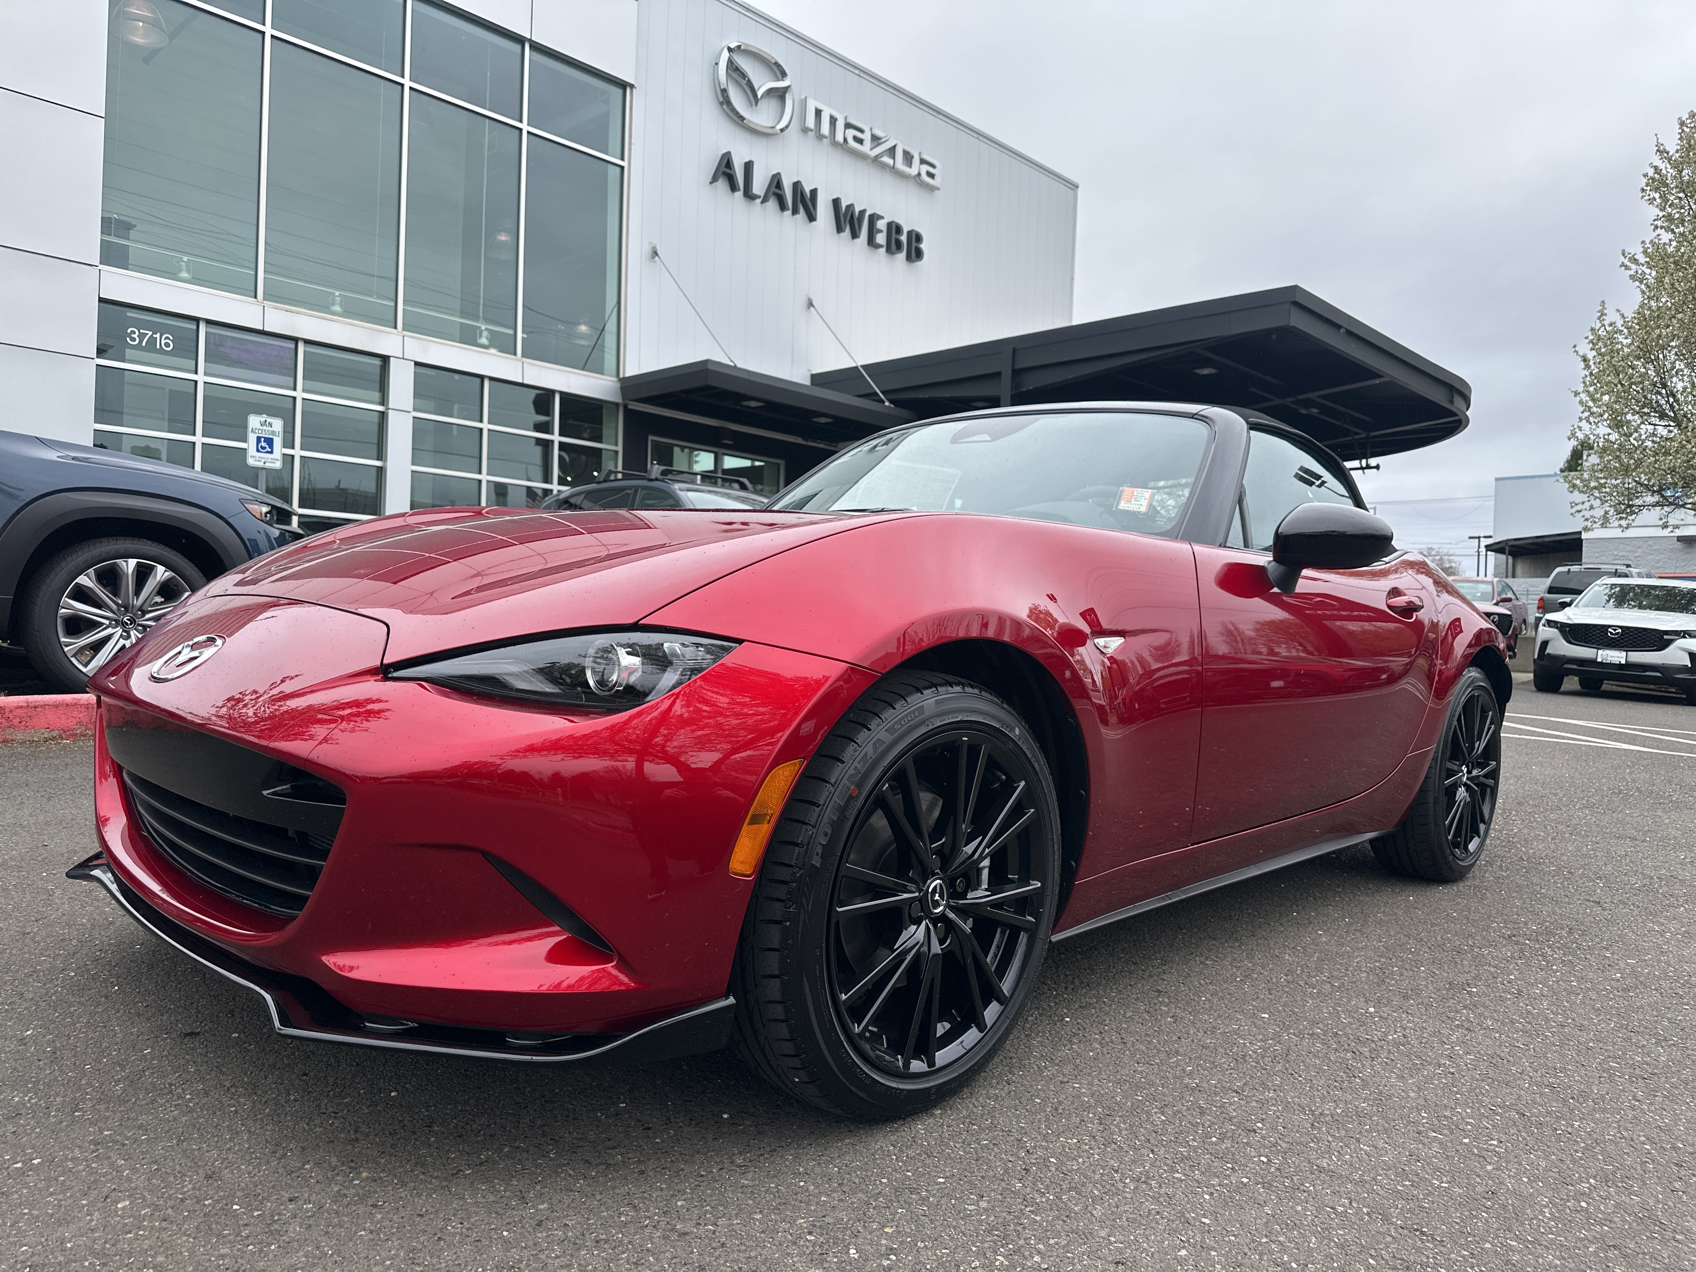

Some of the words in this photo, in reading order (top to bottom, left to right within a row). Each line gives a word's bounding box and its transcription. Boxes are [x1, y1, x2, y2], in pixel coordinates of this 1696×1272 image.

[801, 96, 941, 191] mazda
[709, 150, 818, 223] ALAN
[832, 197, 924, 263] WEBB
[126, 327, 174, 351] 3716
[250, 427, 281, 437] ACCESSIBLE
[259, 419, 273, 428] VAN
[812, 737, 886, 867] POTENZA
